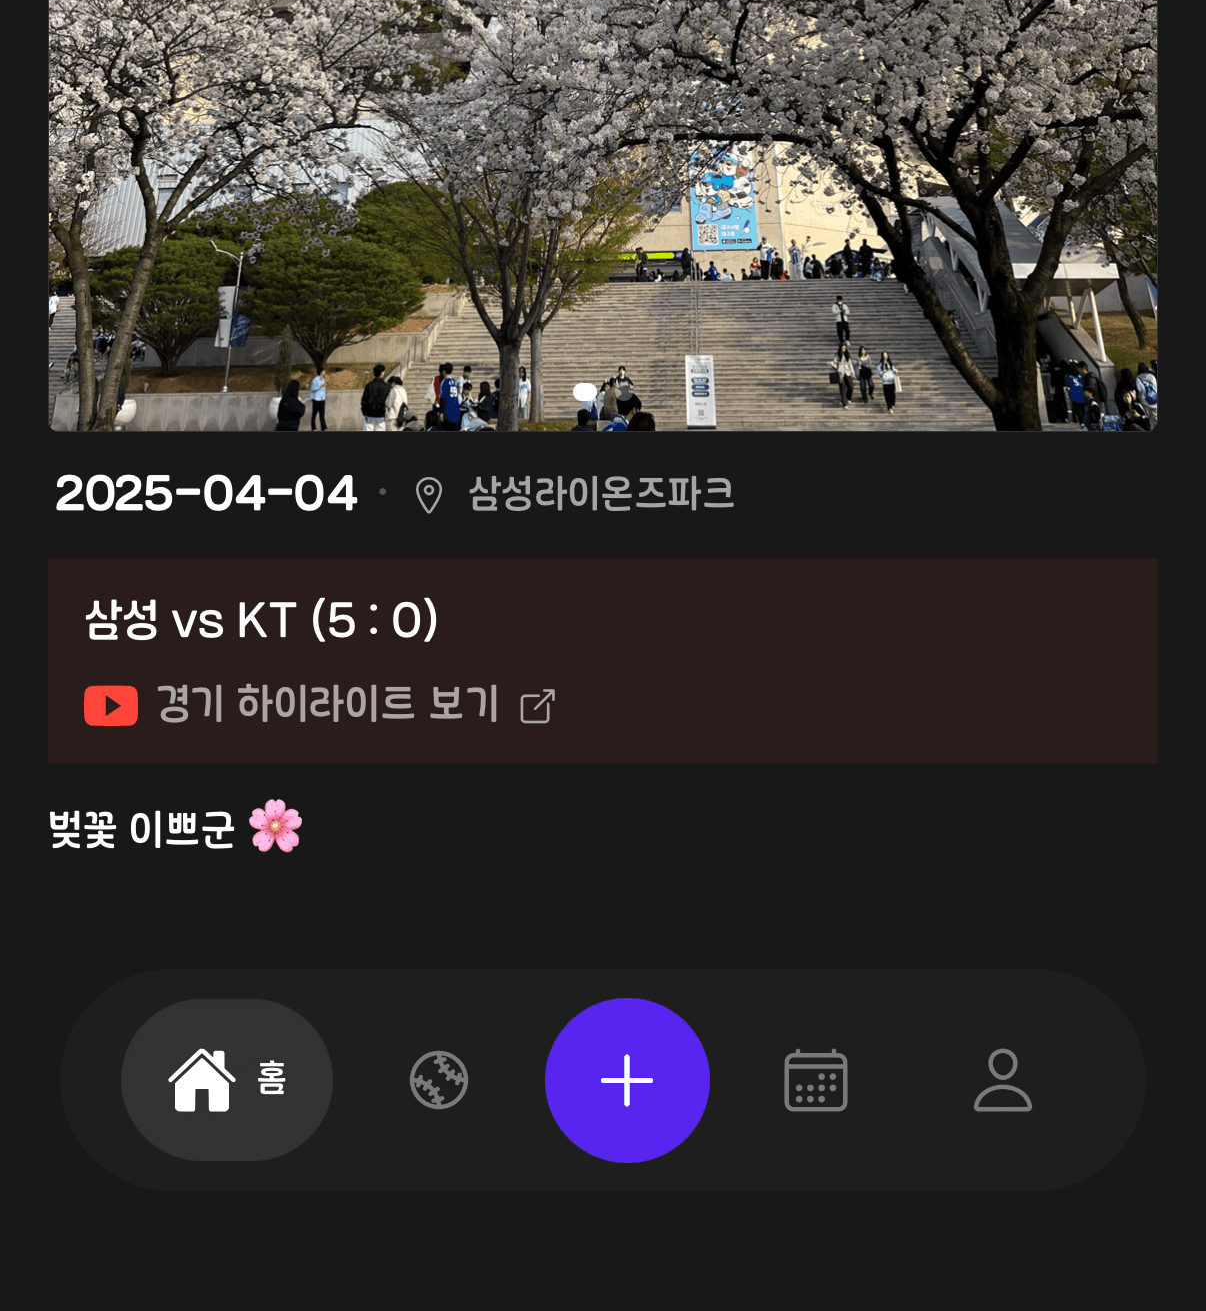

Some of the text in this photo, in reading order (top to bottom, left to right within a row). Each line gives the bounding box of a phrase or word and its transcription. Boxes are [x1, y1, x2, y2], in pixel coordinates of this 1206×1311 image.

[55, 473, 359, 512] 2025-04-04
[468, 475, 735, 512] 삼성라이온즈파크
[84, 598, 158, 641] 삼성
[171, 609, 224, 639] vs
[238, 601, 298, 639] KT
[312, 596, 356, 643] (5
[392, 596, 438, 643] 0)
[157, 682, 498, 724] 경기 하이라이트 보기
[49, 809, 236, 850] 벚꽃 이쁘군
[257, 1059, 287, 1095] 홈
